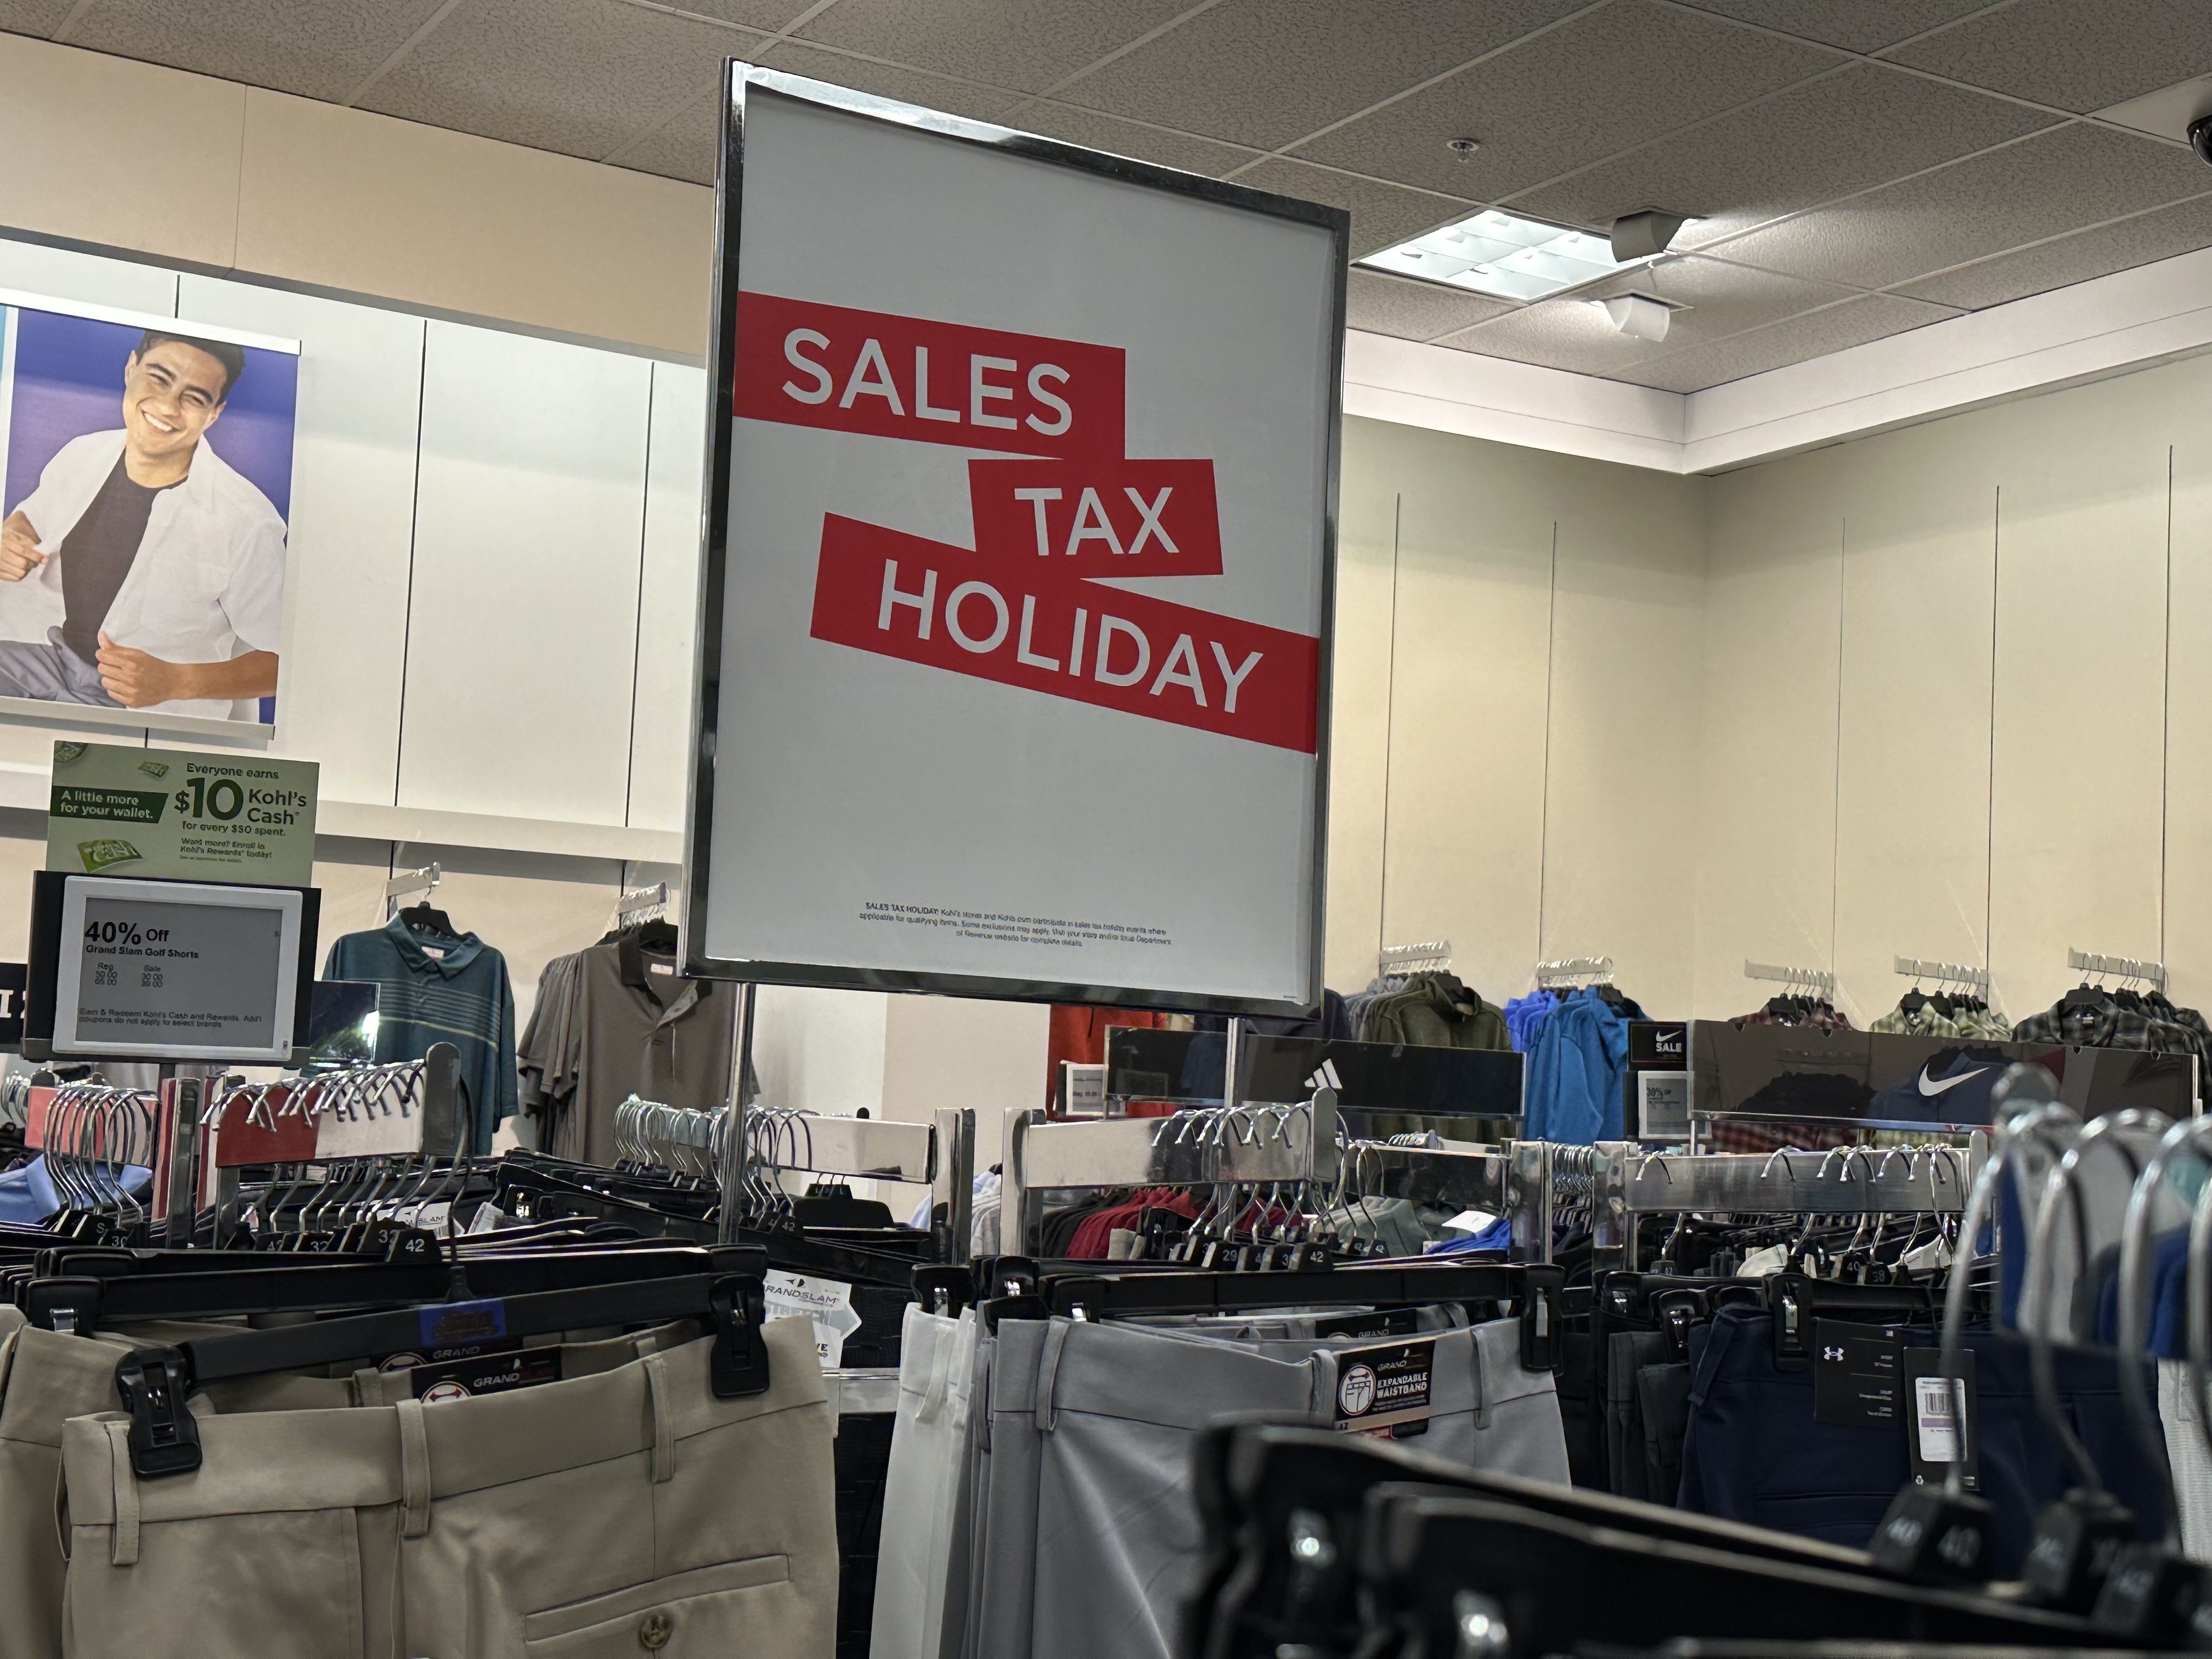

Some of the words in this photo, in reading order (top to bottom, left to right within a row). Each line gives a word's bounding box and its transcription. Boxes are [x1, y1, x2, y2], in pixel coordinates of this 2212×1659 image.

[781, 328, 1073, 437] SALES
[1014, 487, 1180, 556] TAX
[877, 558, 1264, 714] HOLIDAY
[187, 763, 243, 776] Everyone
[247, 770, 279, 779] earns
[61, 790, 71, 800] A
[75, 791, 103, 803] little
[106, 795, 139, 805] more
[174, 777, 244, 821] $10
[249, 788, 307, 807] Kohl's
[60, 802, 78, 813] for
[82, 805, 109, 816] your
[114, 807, 154, 819] wallet.
[183, 821, 196, 830] for
[200, 825, 228, 834] every
[255, 827, 286, 837] spent.
[866, 902, 889, 911] SALES
[891, 904, 905, 912] TAX
[84, 921, 141, 945] 40%
[146, 928, 170, 942] Off
[86, 945, 116, 954] Grand
[119, 946, 143, 956] Slam
[145, 948, 166, 956] Golf
[168, 949, 199, 958] Shorts
[1656, 1042, 1681, 1053] SALE
[782, 1221, 795, 1232] 42
[405, 1238, 425, 1252] 42
[1310, 1251, 1324, 1263] 42
[1872, 1270, 1885, 1283] 38
[761, 1284, 839, 1304] RANDSLAM
[433, 1346, 480, 1359] GRAND
[473, 1373, 520, 1387] GRAND
[1378, 1372, 1427, 1389] EXPANDABLE
[1377, 1382, 1427, 1398] WAISTBAND
